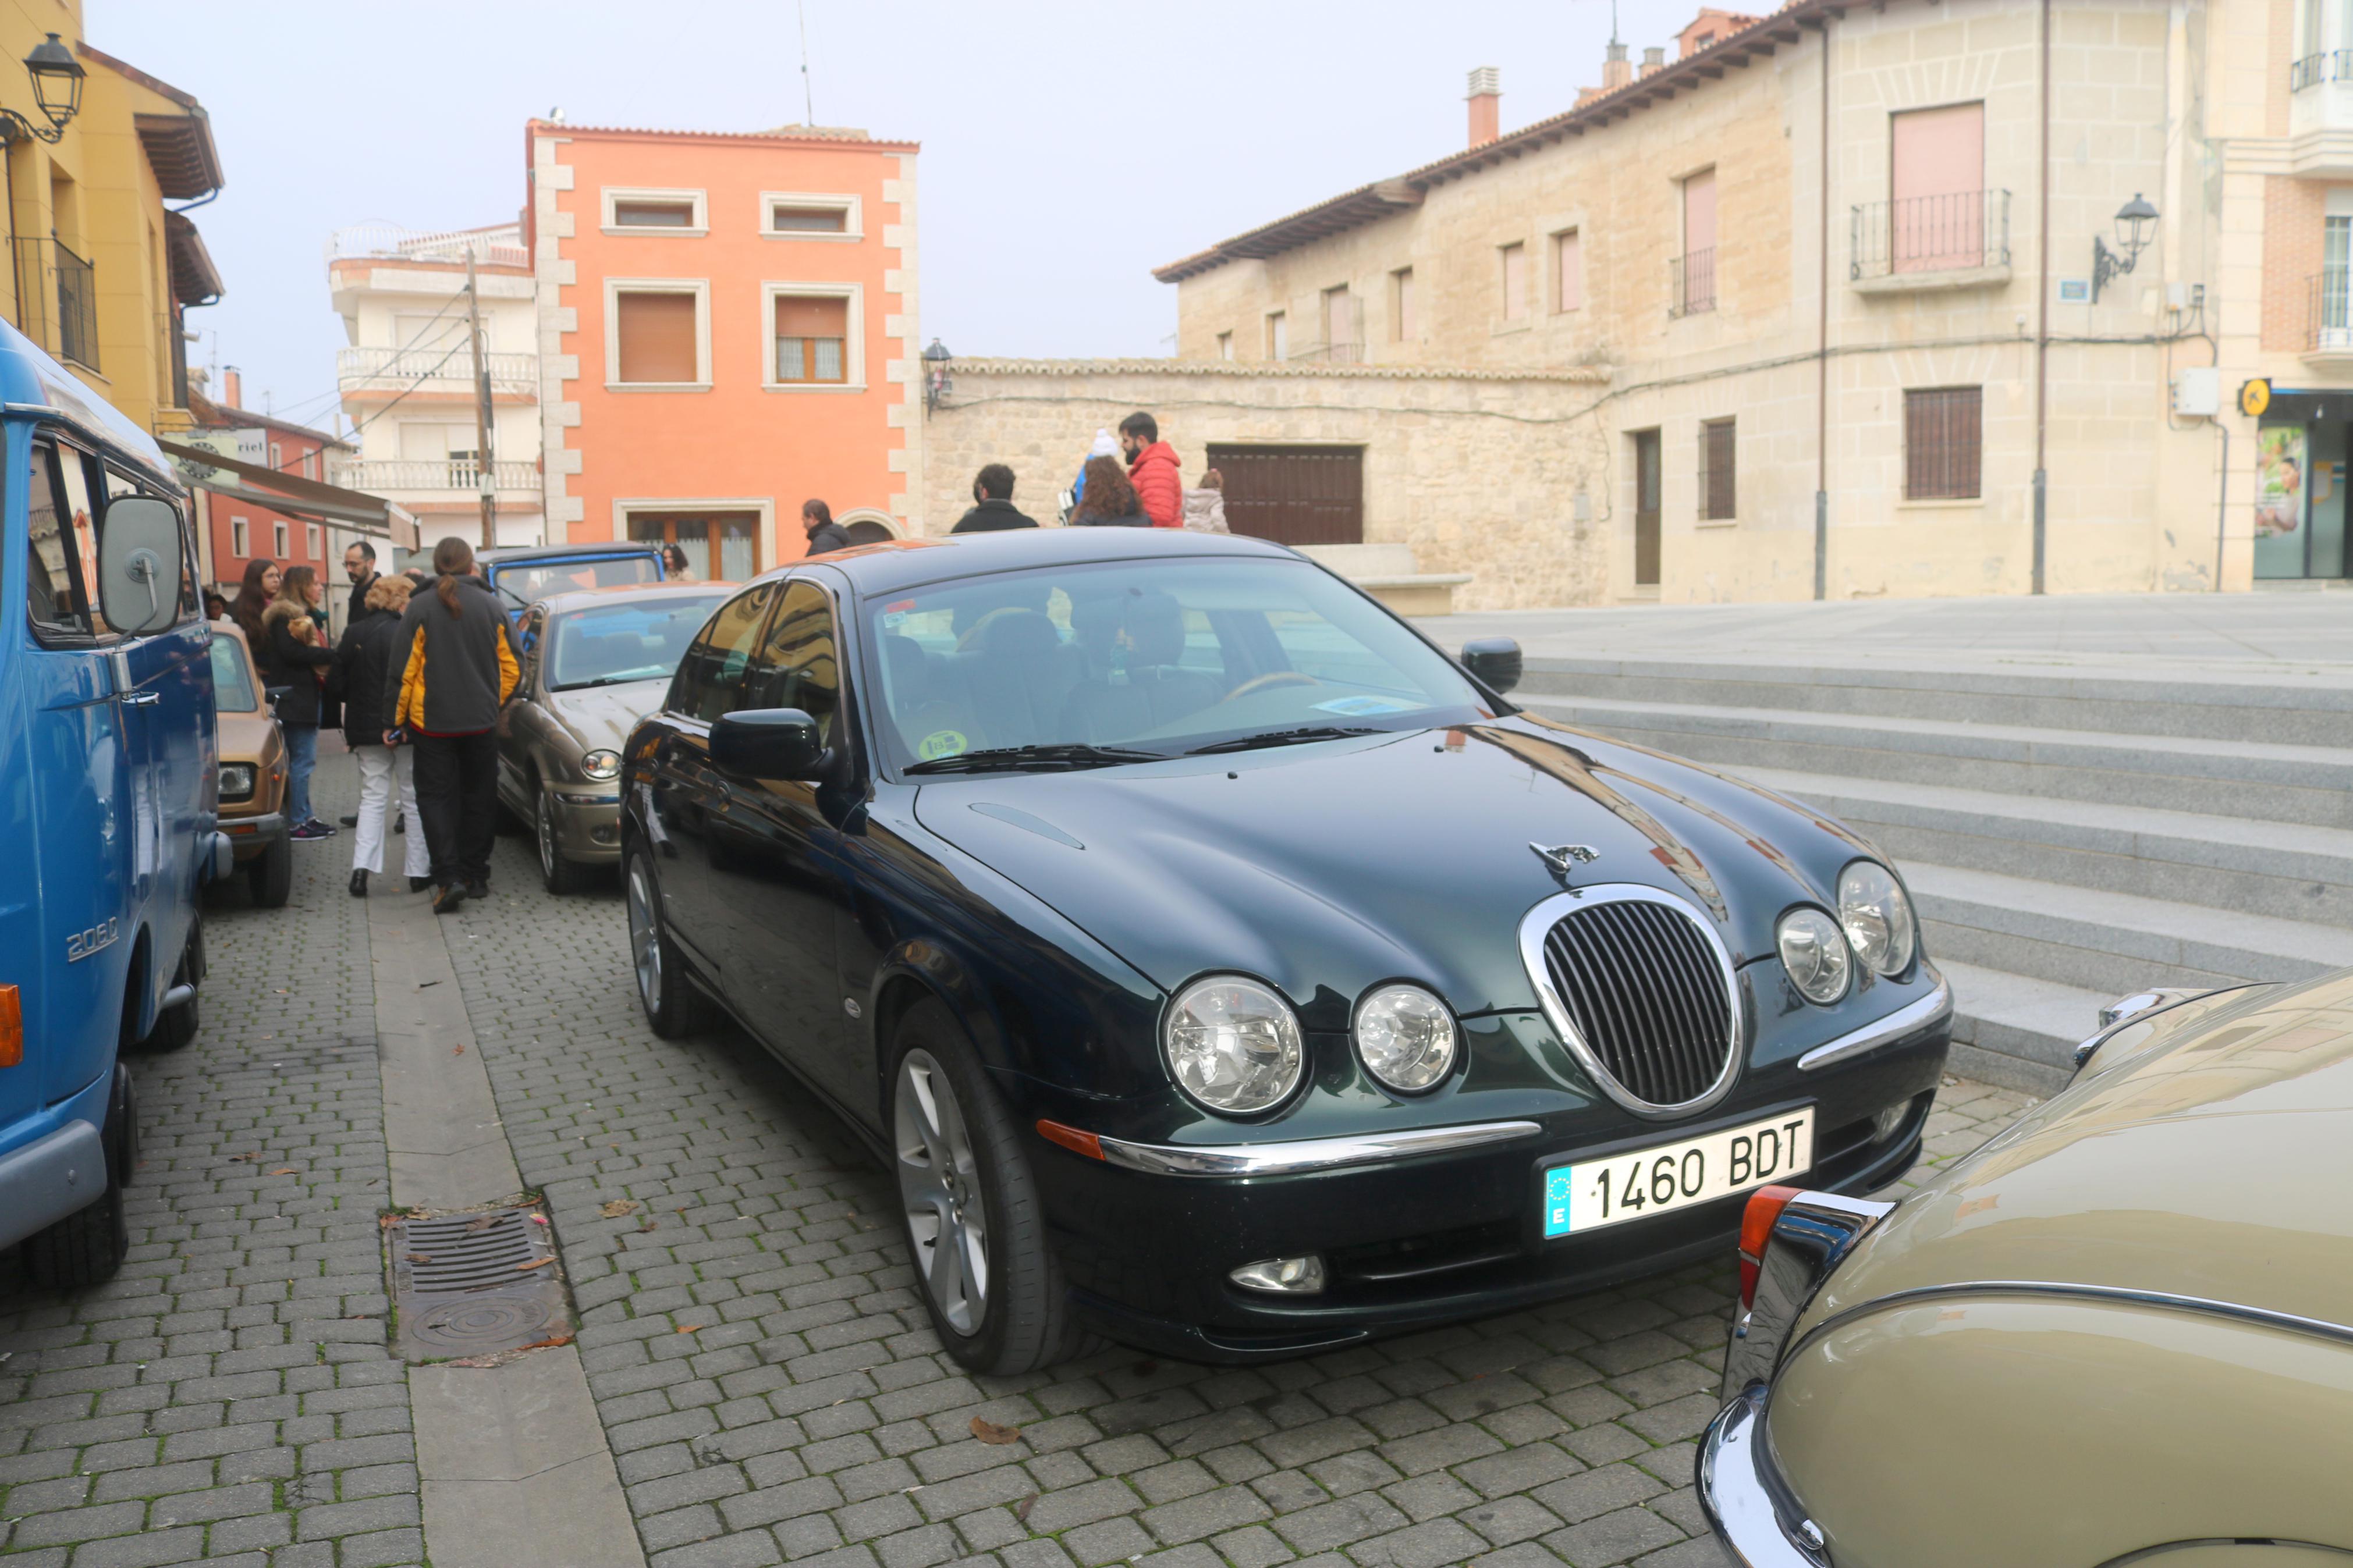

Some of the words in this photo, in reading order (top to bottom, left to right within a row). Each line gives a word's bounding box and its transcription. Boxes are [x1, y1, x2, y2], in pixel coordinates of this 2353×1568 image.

[1597, 1149, 1704, 1218] 1460
[1730, 1119, 1804, 1186] BDT
[1553, 1208, 1565, 1224] E
